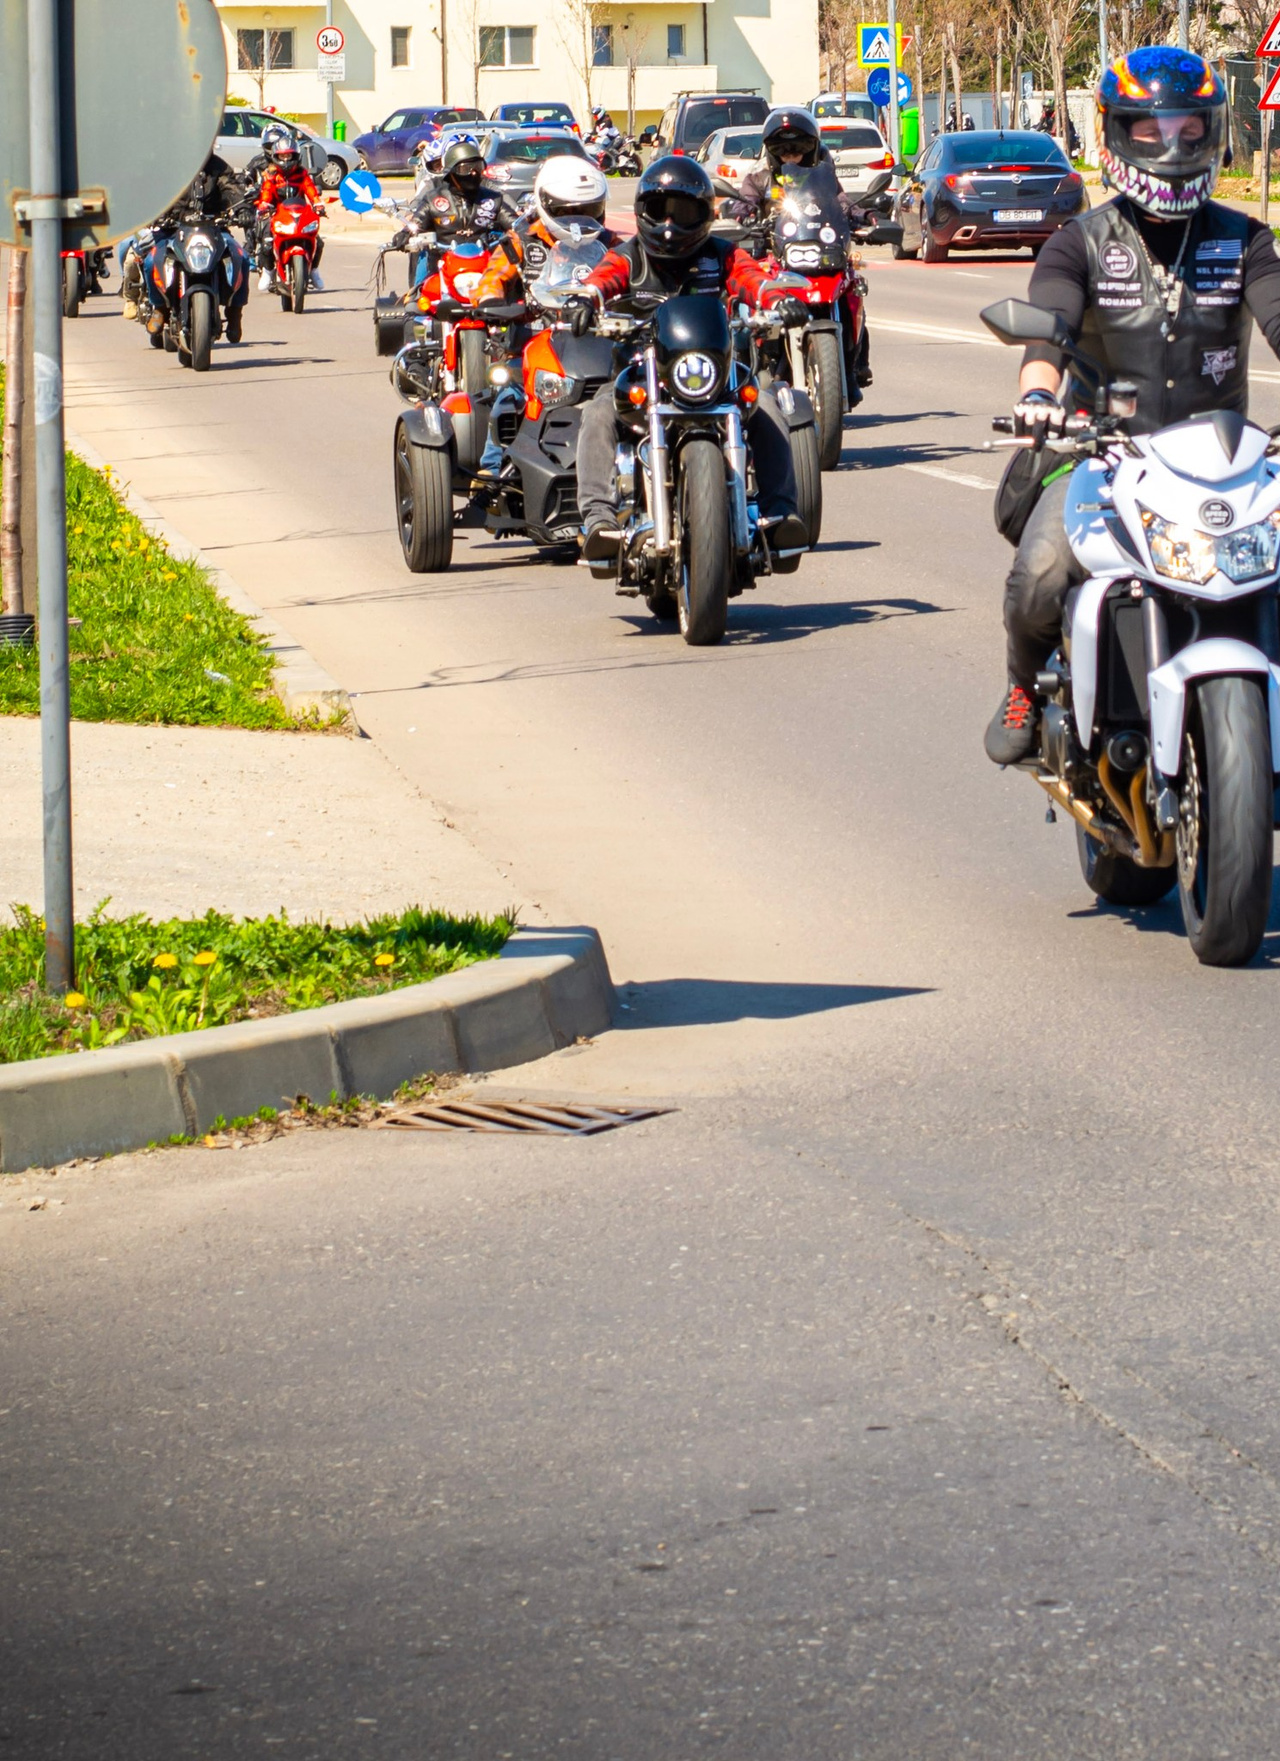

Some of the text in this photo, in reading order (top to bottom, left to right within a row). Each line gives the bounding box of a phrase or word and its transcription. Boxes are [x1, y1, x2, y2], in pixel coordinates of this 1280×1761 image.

[1106, 255, 1128, 263] SPEED
[1110, 263, 1128, 271] LIMIT
[1107, 282, 1126, 291] SPEED
[1126, 283, 1141, 291] LIMIT
[1098, 297, 1142, 307] ROMANIA
